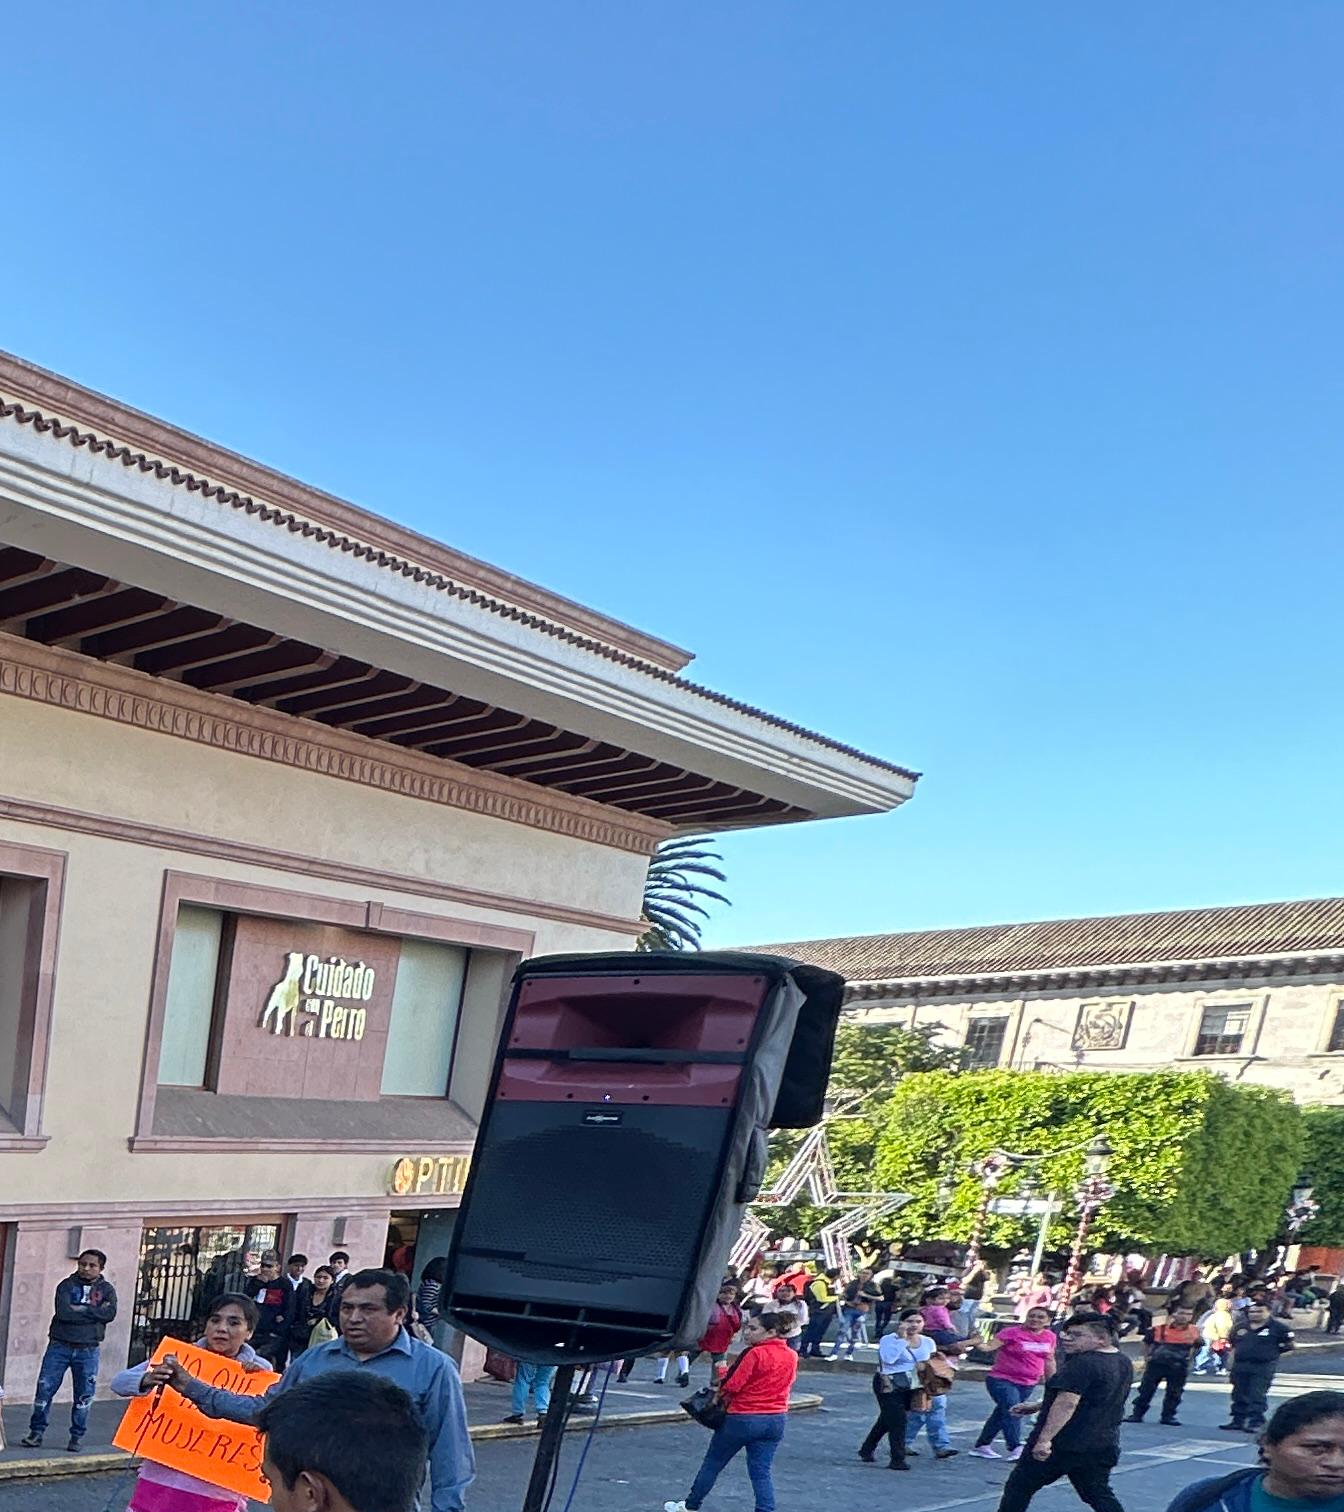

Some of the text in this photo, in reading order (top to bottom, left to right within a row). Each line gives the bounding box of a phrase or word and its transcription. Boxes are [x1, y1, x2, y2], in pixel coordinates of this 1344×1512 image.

[303, 955, 375, 1001] Cuidado
[319, 1000, 367, 1041] Perro
[134, 1410, 263, 1472] MUJERES
